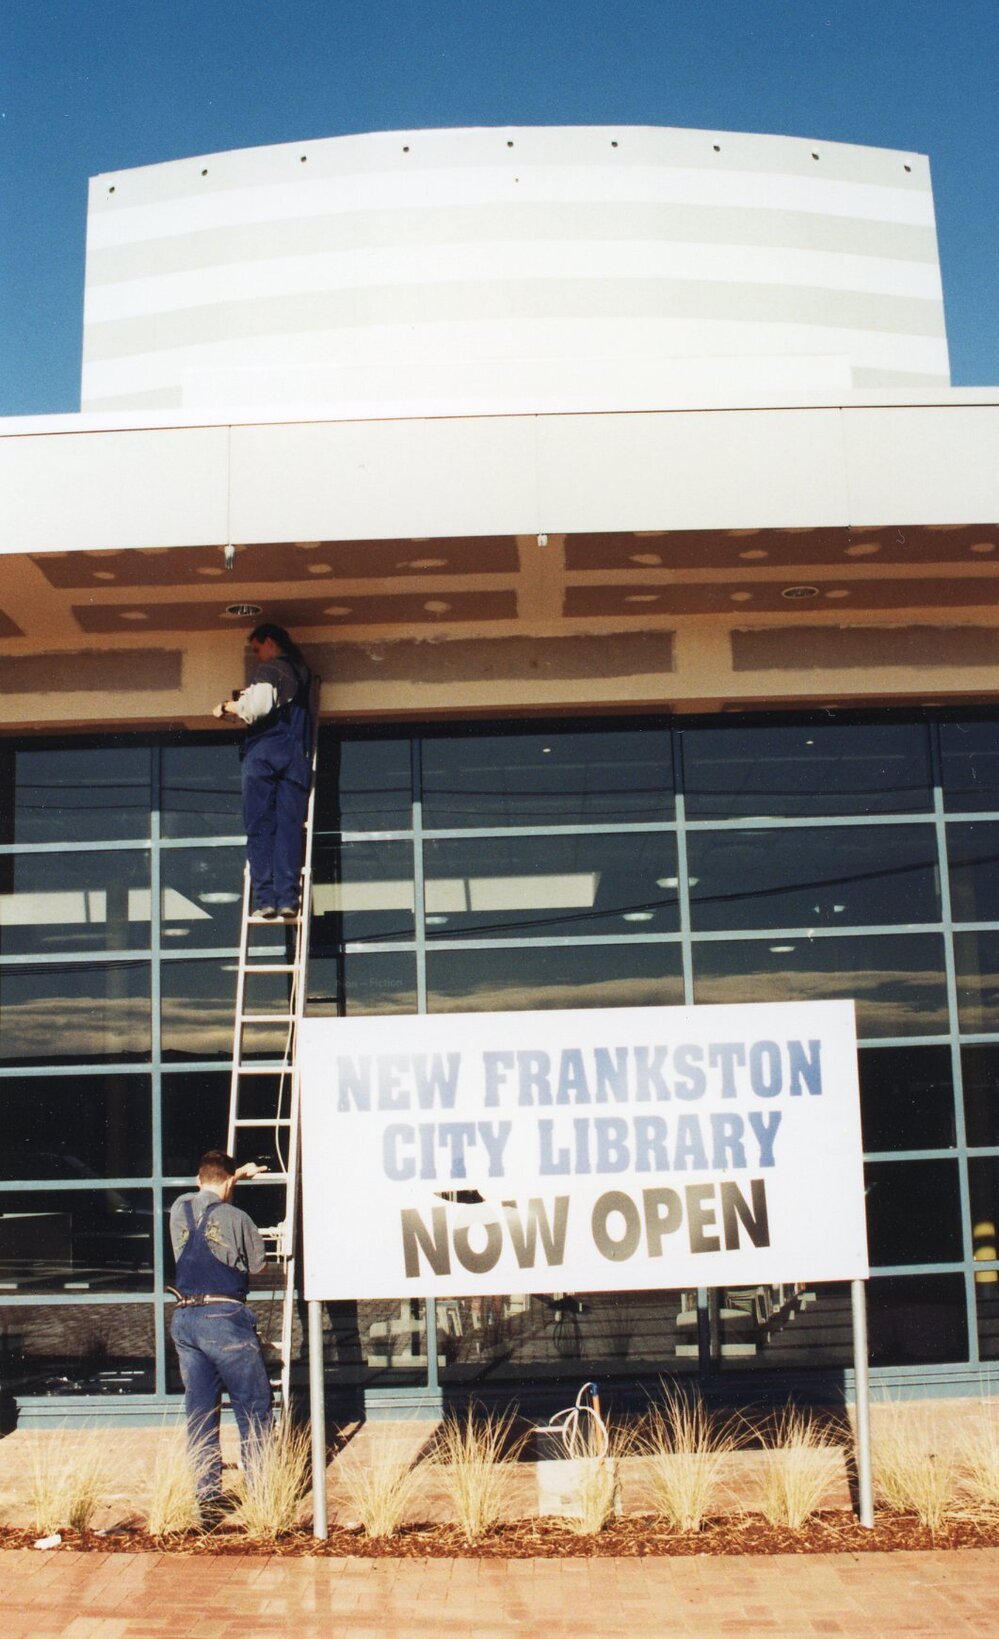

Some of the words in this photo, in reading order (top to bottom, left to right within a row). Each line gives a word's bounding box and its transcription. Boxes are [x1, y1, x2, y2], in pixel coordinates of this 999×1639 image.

[336, 1052, 461, 1112] NEW
[483, 1039, 823, 1108] FRANKSTON
[382, 1120, 512, 1182] CITY
[538, 1110, 782, 1176] LIBRARY
[400, 1195, 570, 1278] NOW
[591, 1178, 770, 1262] OPEN
